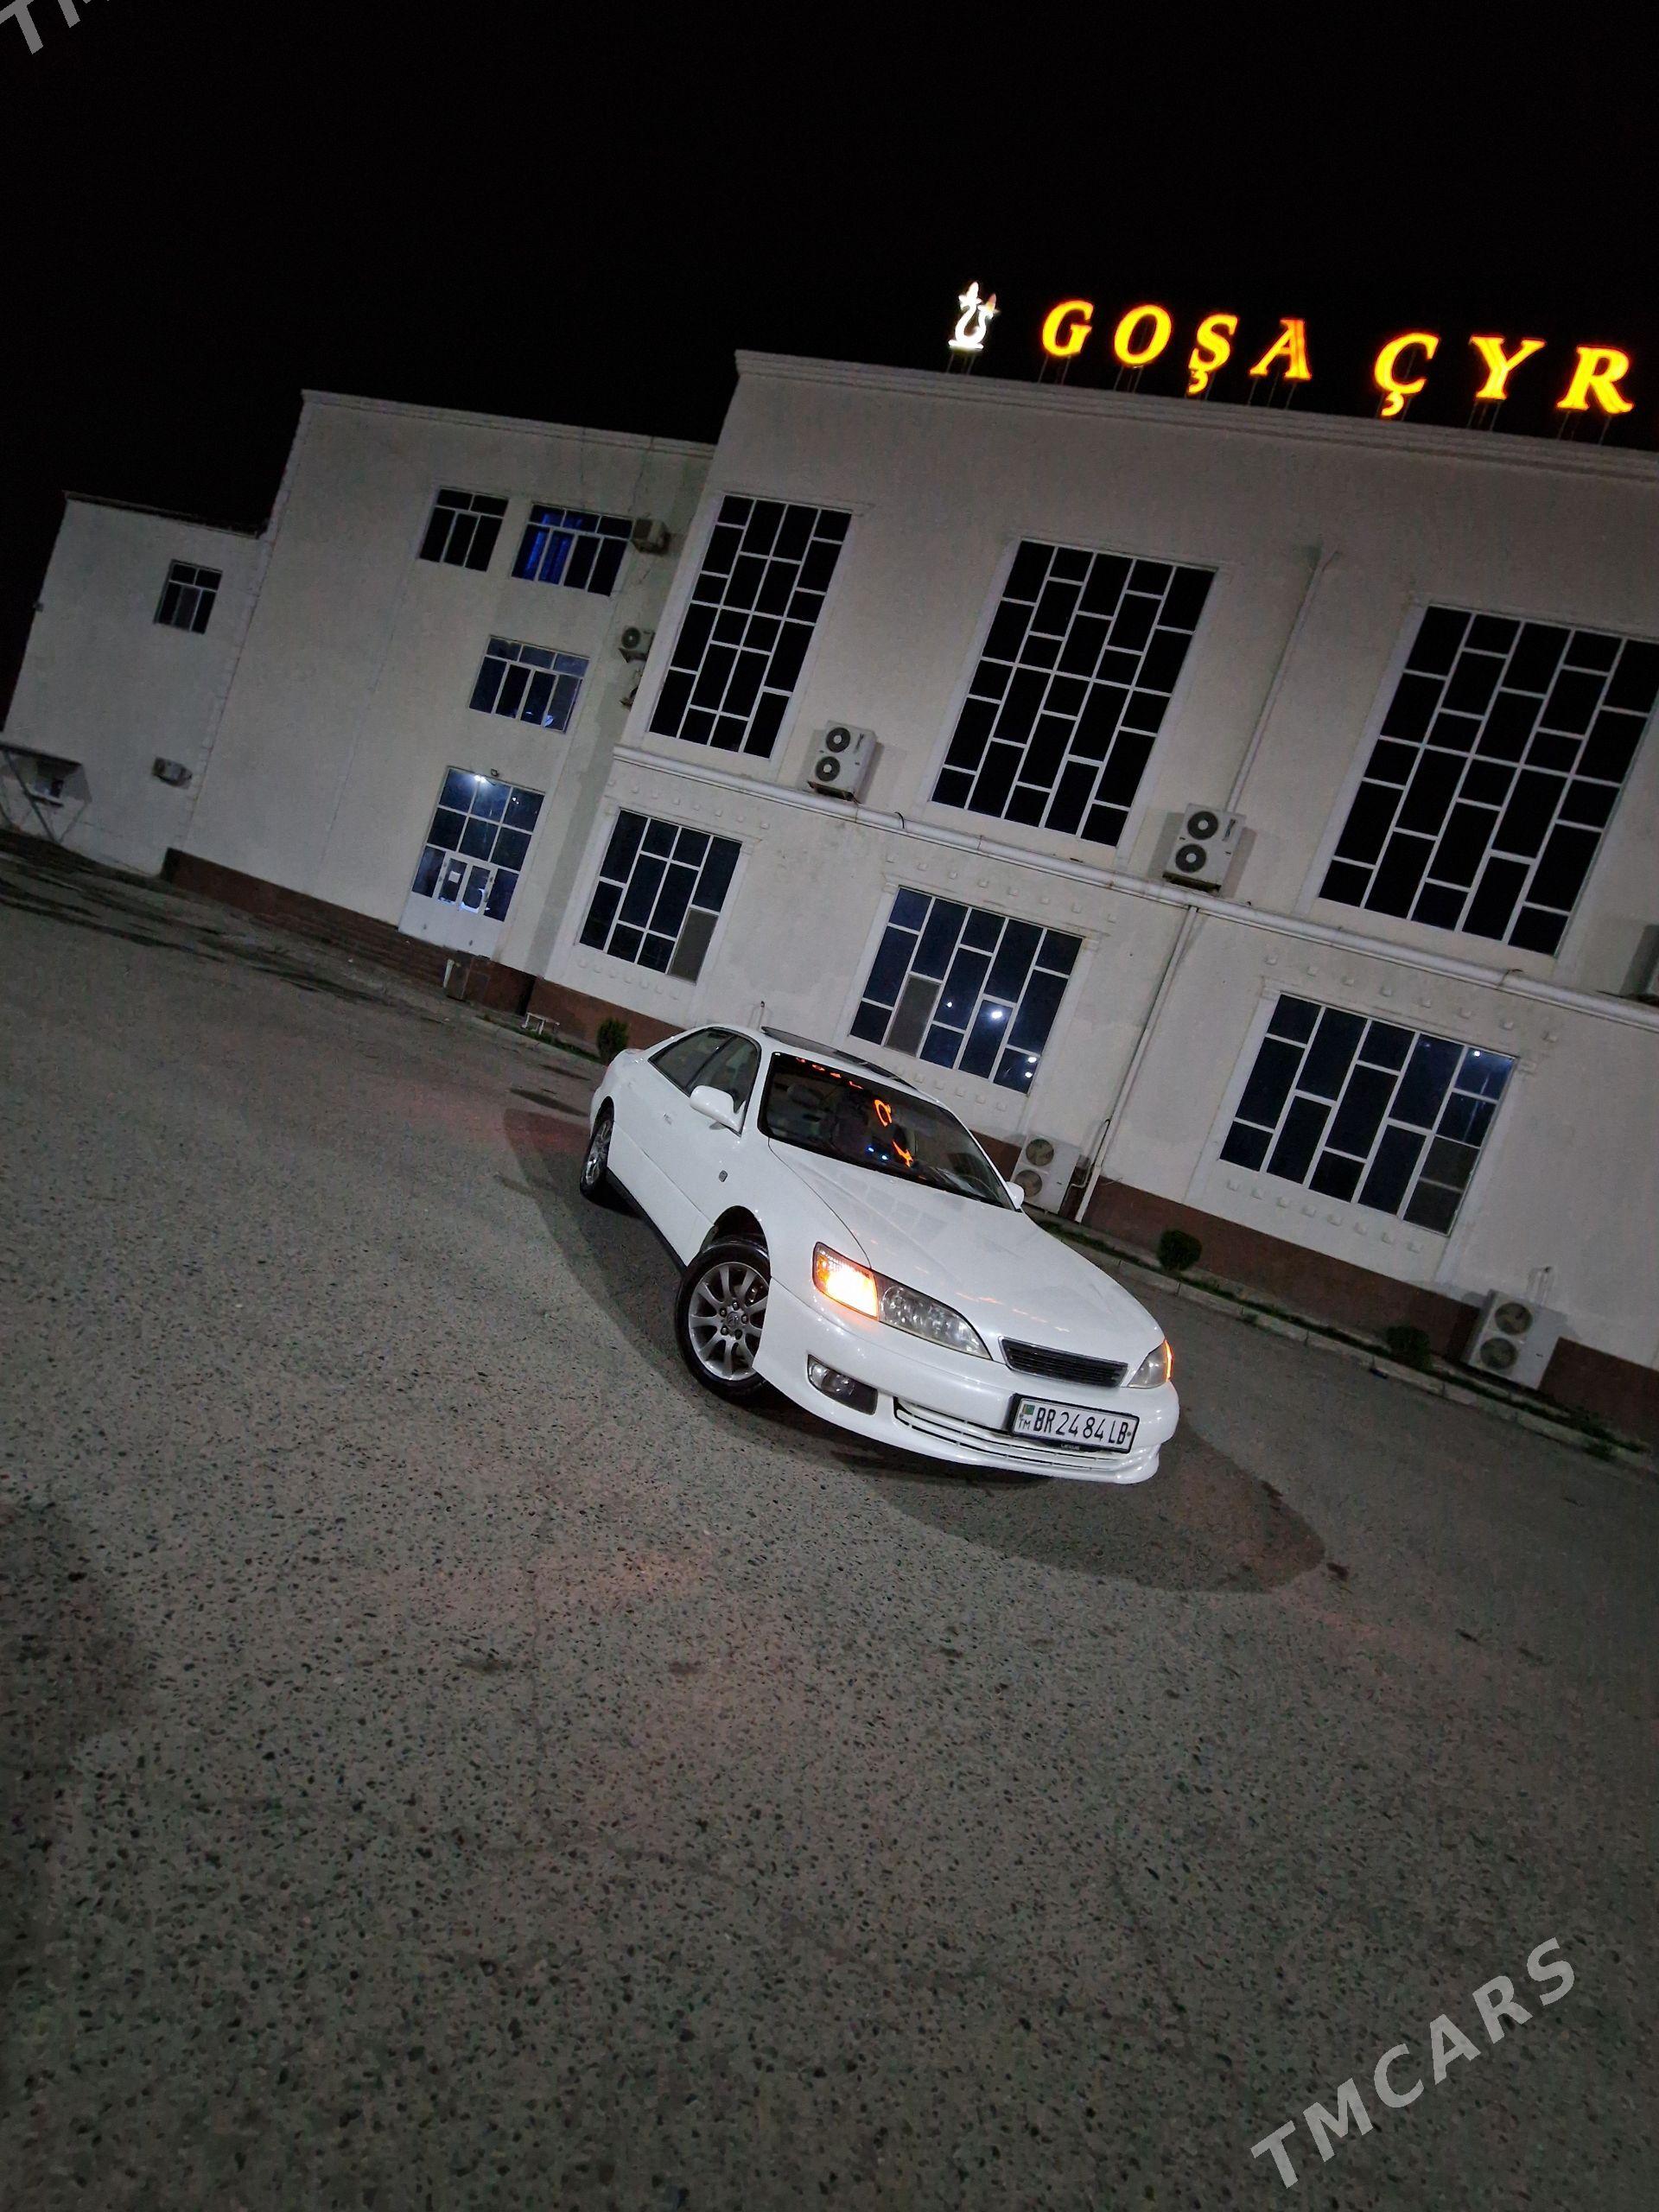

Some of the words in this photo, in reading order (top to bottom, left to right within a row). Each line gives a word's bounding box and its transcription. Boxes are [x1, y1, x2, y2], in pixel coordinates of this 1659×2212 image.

[1040, 299, 1313, 395] GOŞA
[1374, 331, 1634, 416] ÇYR
[1018, 1418, 1032, 1431] TM
